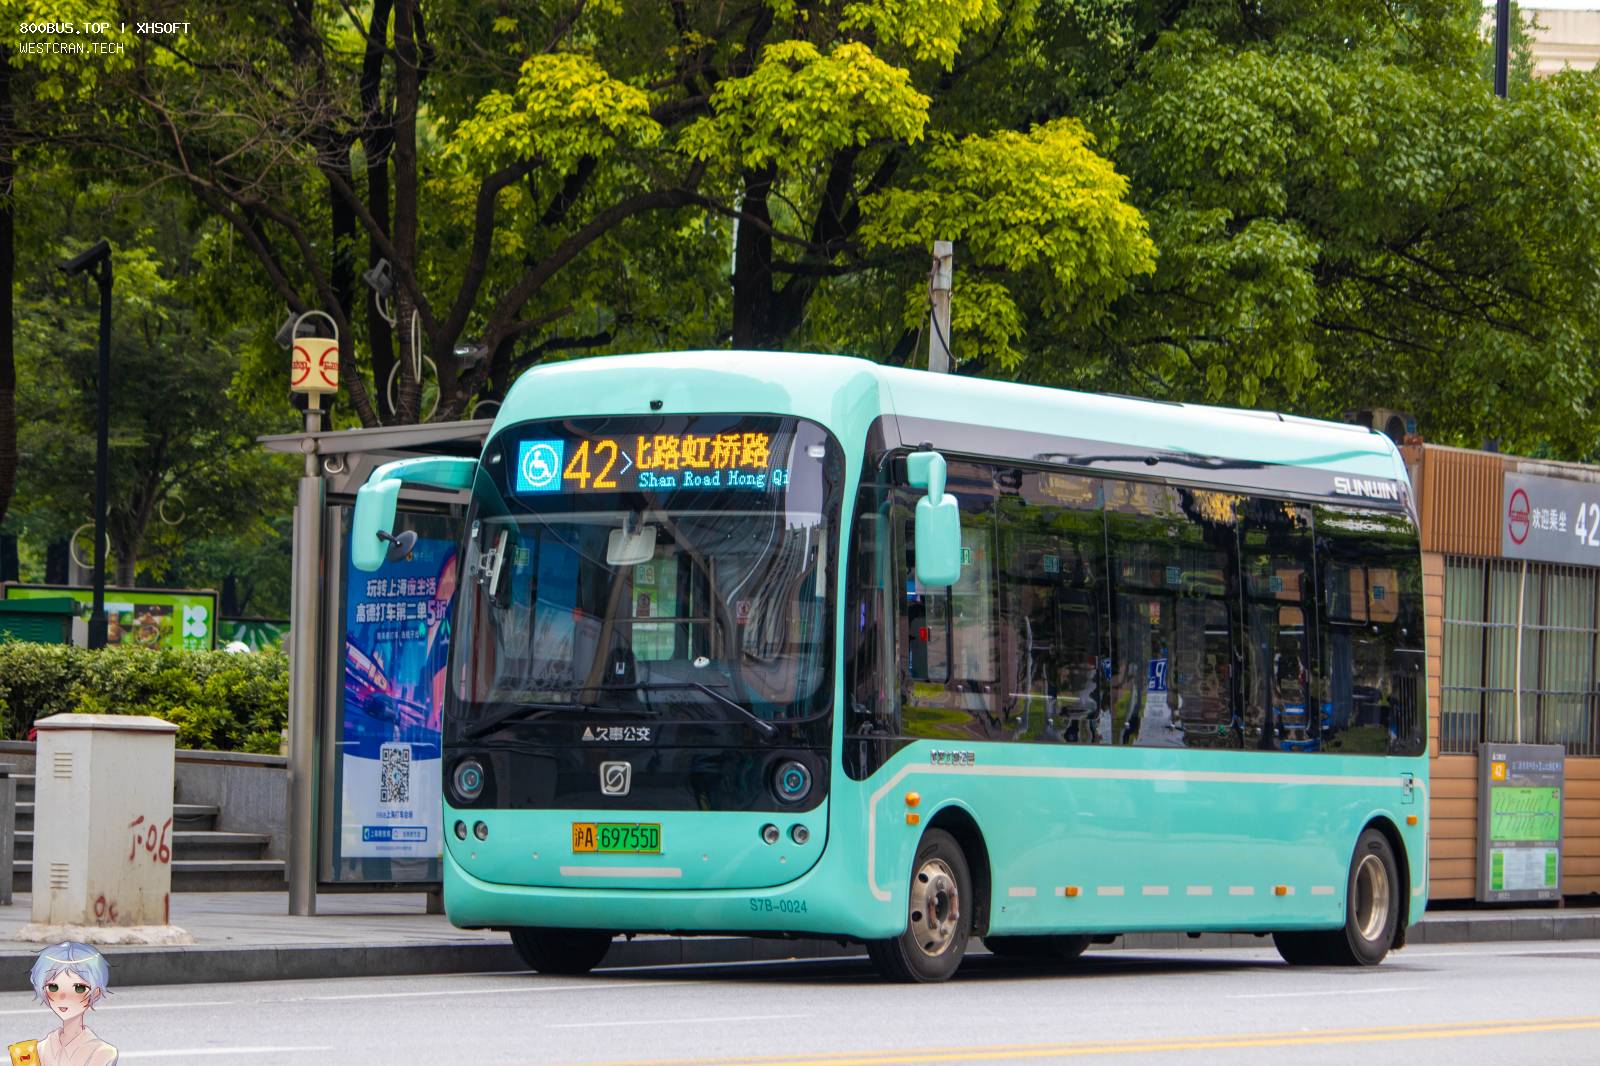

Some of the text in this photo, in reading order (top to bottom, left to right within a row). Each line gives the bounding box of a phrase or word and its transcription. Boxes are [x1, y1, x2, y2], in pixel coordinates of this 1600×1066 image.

[563, 439, 619, 489] 42
[638, 471, 676, 487] Shan
[683, 470, 720, 487] Road
[727, 470, 766, 488] Hong
[1334, 476, 1398, 501] SUNWIN
[1532, 506, 1567, 532] 欢迎乘坐
[1575, 502, 1600, 546] 42
[366, 576, 436, 598] 玩转上海夜生活
[595, 726, 650, 742] 久事公交
[601, 827, 659, 849] 69755D
[750, 897, 808, 913] S7B-0024
